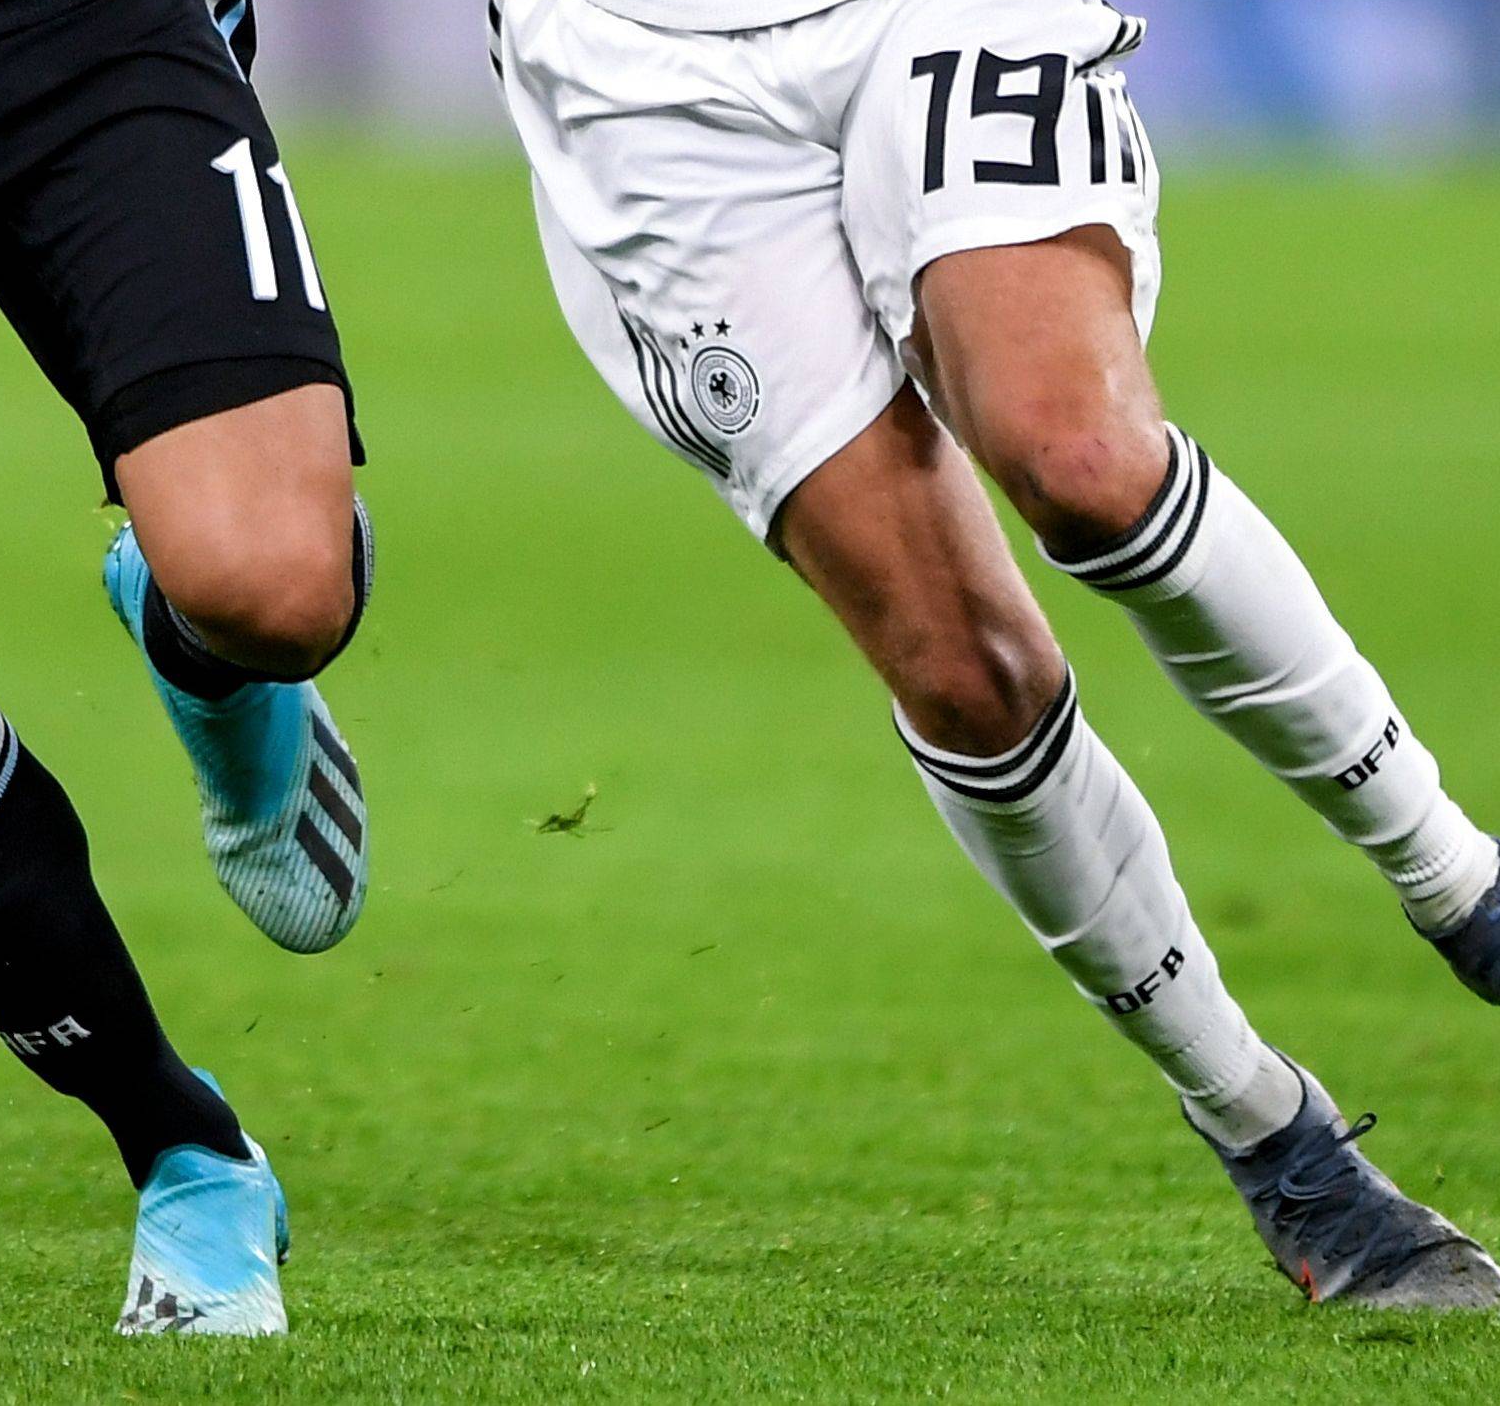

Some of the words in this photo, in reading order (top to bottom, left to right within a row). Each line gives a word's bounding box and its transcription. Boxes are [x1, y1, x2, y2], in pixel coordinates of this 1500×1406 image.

[910, 47, 1068, 196] 19
[210, 137, 327, 312] 11
[1333, 715, 1400, 791] DFB
[1104, 945, 1186, 1016] DFB
